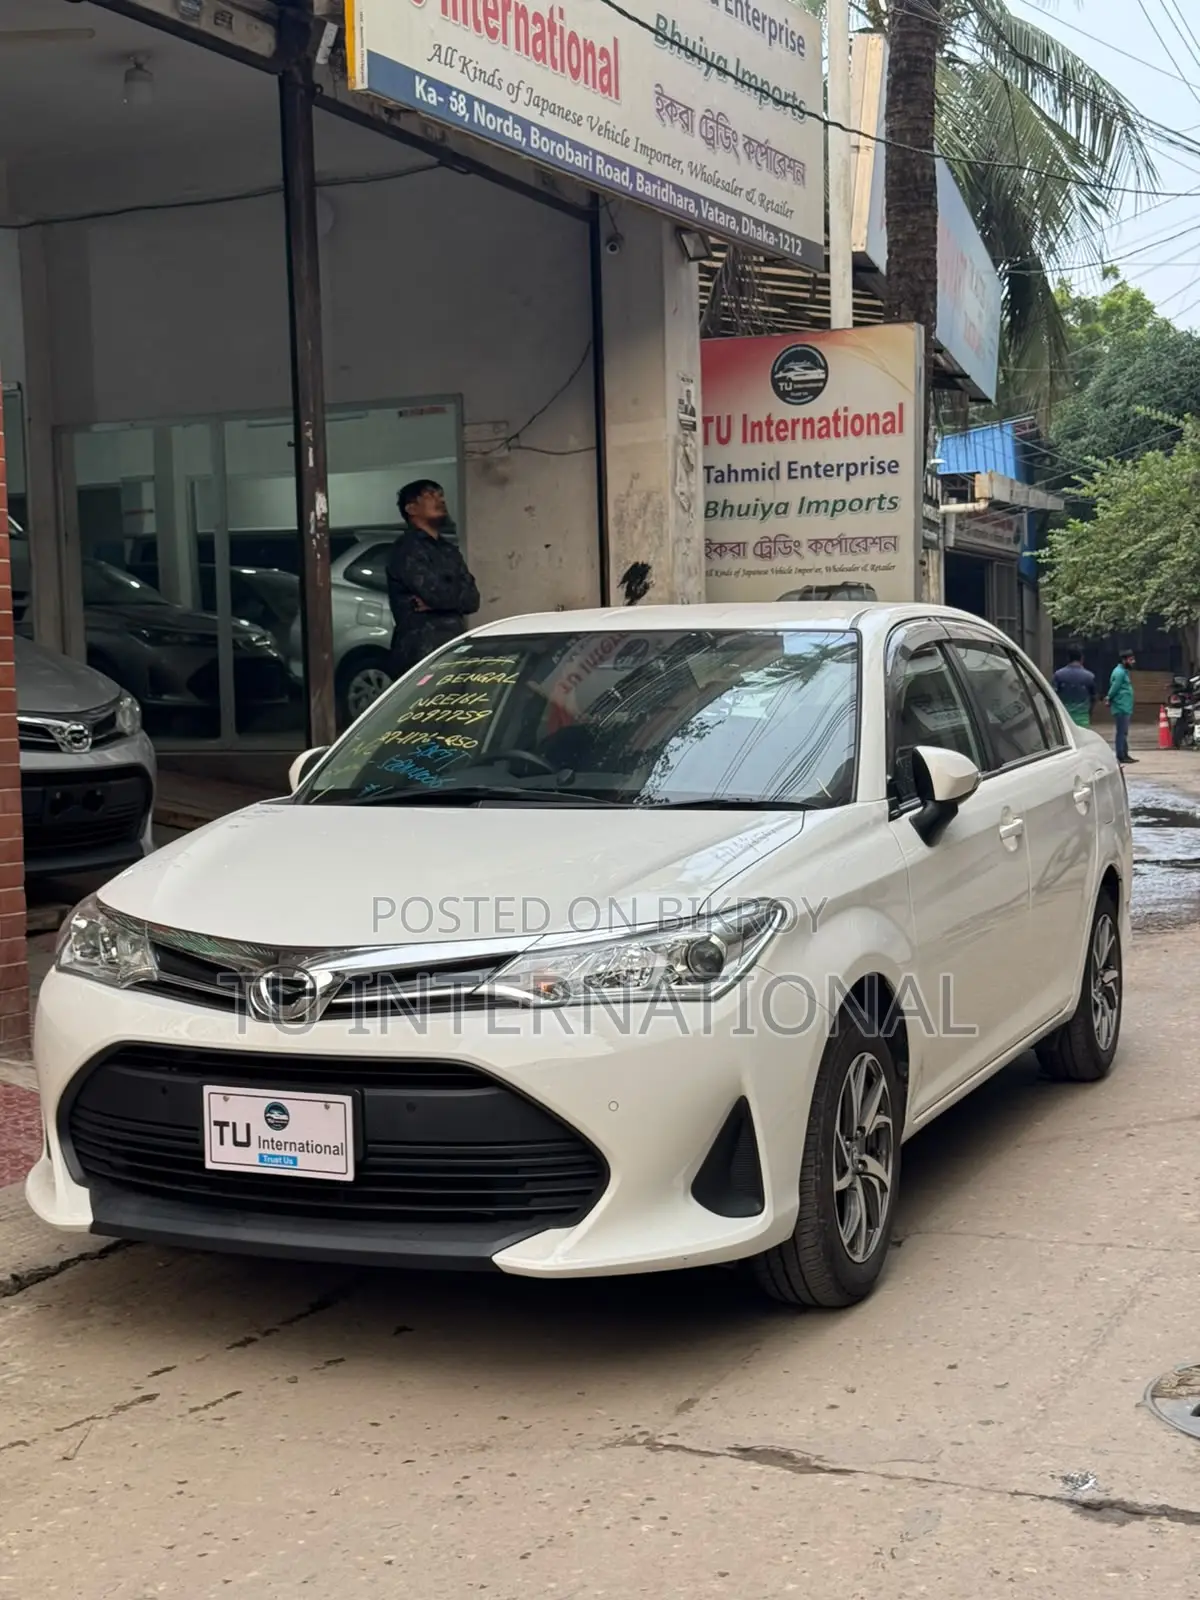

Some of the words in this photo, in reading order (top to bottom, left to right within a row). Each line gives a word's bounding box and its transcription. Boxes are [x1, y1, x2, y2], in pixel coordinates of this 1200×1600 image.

[654, 13, 728, 78] Bhuiya
[734, 58, 806, 119] Imports
[427, 43, 457, 68] All
[459, 55, 503, 91] Kinds
[507, 80, 524, 103] of
[526, 87, 582, 126] Japanese
[587, 115, 630, 148] Vehicle
[633, 137, 684, 174] Importer,
[687, 160, 743, 199] Wholesaler
[758, 193, 794, 219] Retailer
[415, 75, 444, 106] Ka-
[474, 102, 526, 146] Norda,
[530, 126, 593, 171] Borobari
[596, 156, 634, 190] Road,
[636, 173, 698, 216] Baridhara,
[700, 199, 740, 233] Vatara,
[741, 216, 802, 256] Dhaka-1212
[702, 415, 732, 446] TU
[742, 403, 904, 444] International
[703, 461, 780, 484] Tahmid
[787, 456, 899, 481] Enterprise
[704, 499, 789, 520] Bhuiya
[798, 494, 900, 517] Imports
[436, 672, 520, 685] BENGAL
[213, 1120, 251, 1147] TU
[257, 1136, 344, 1156] International
[263, 1154, 281, 1165] Trust
[282, 1155, 293, 1165] Us
